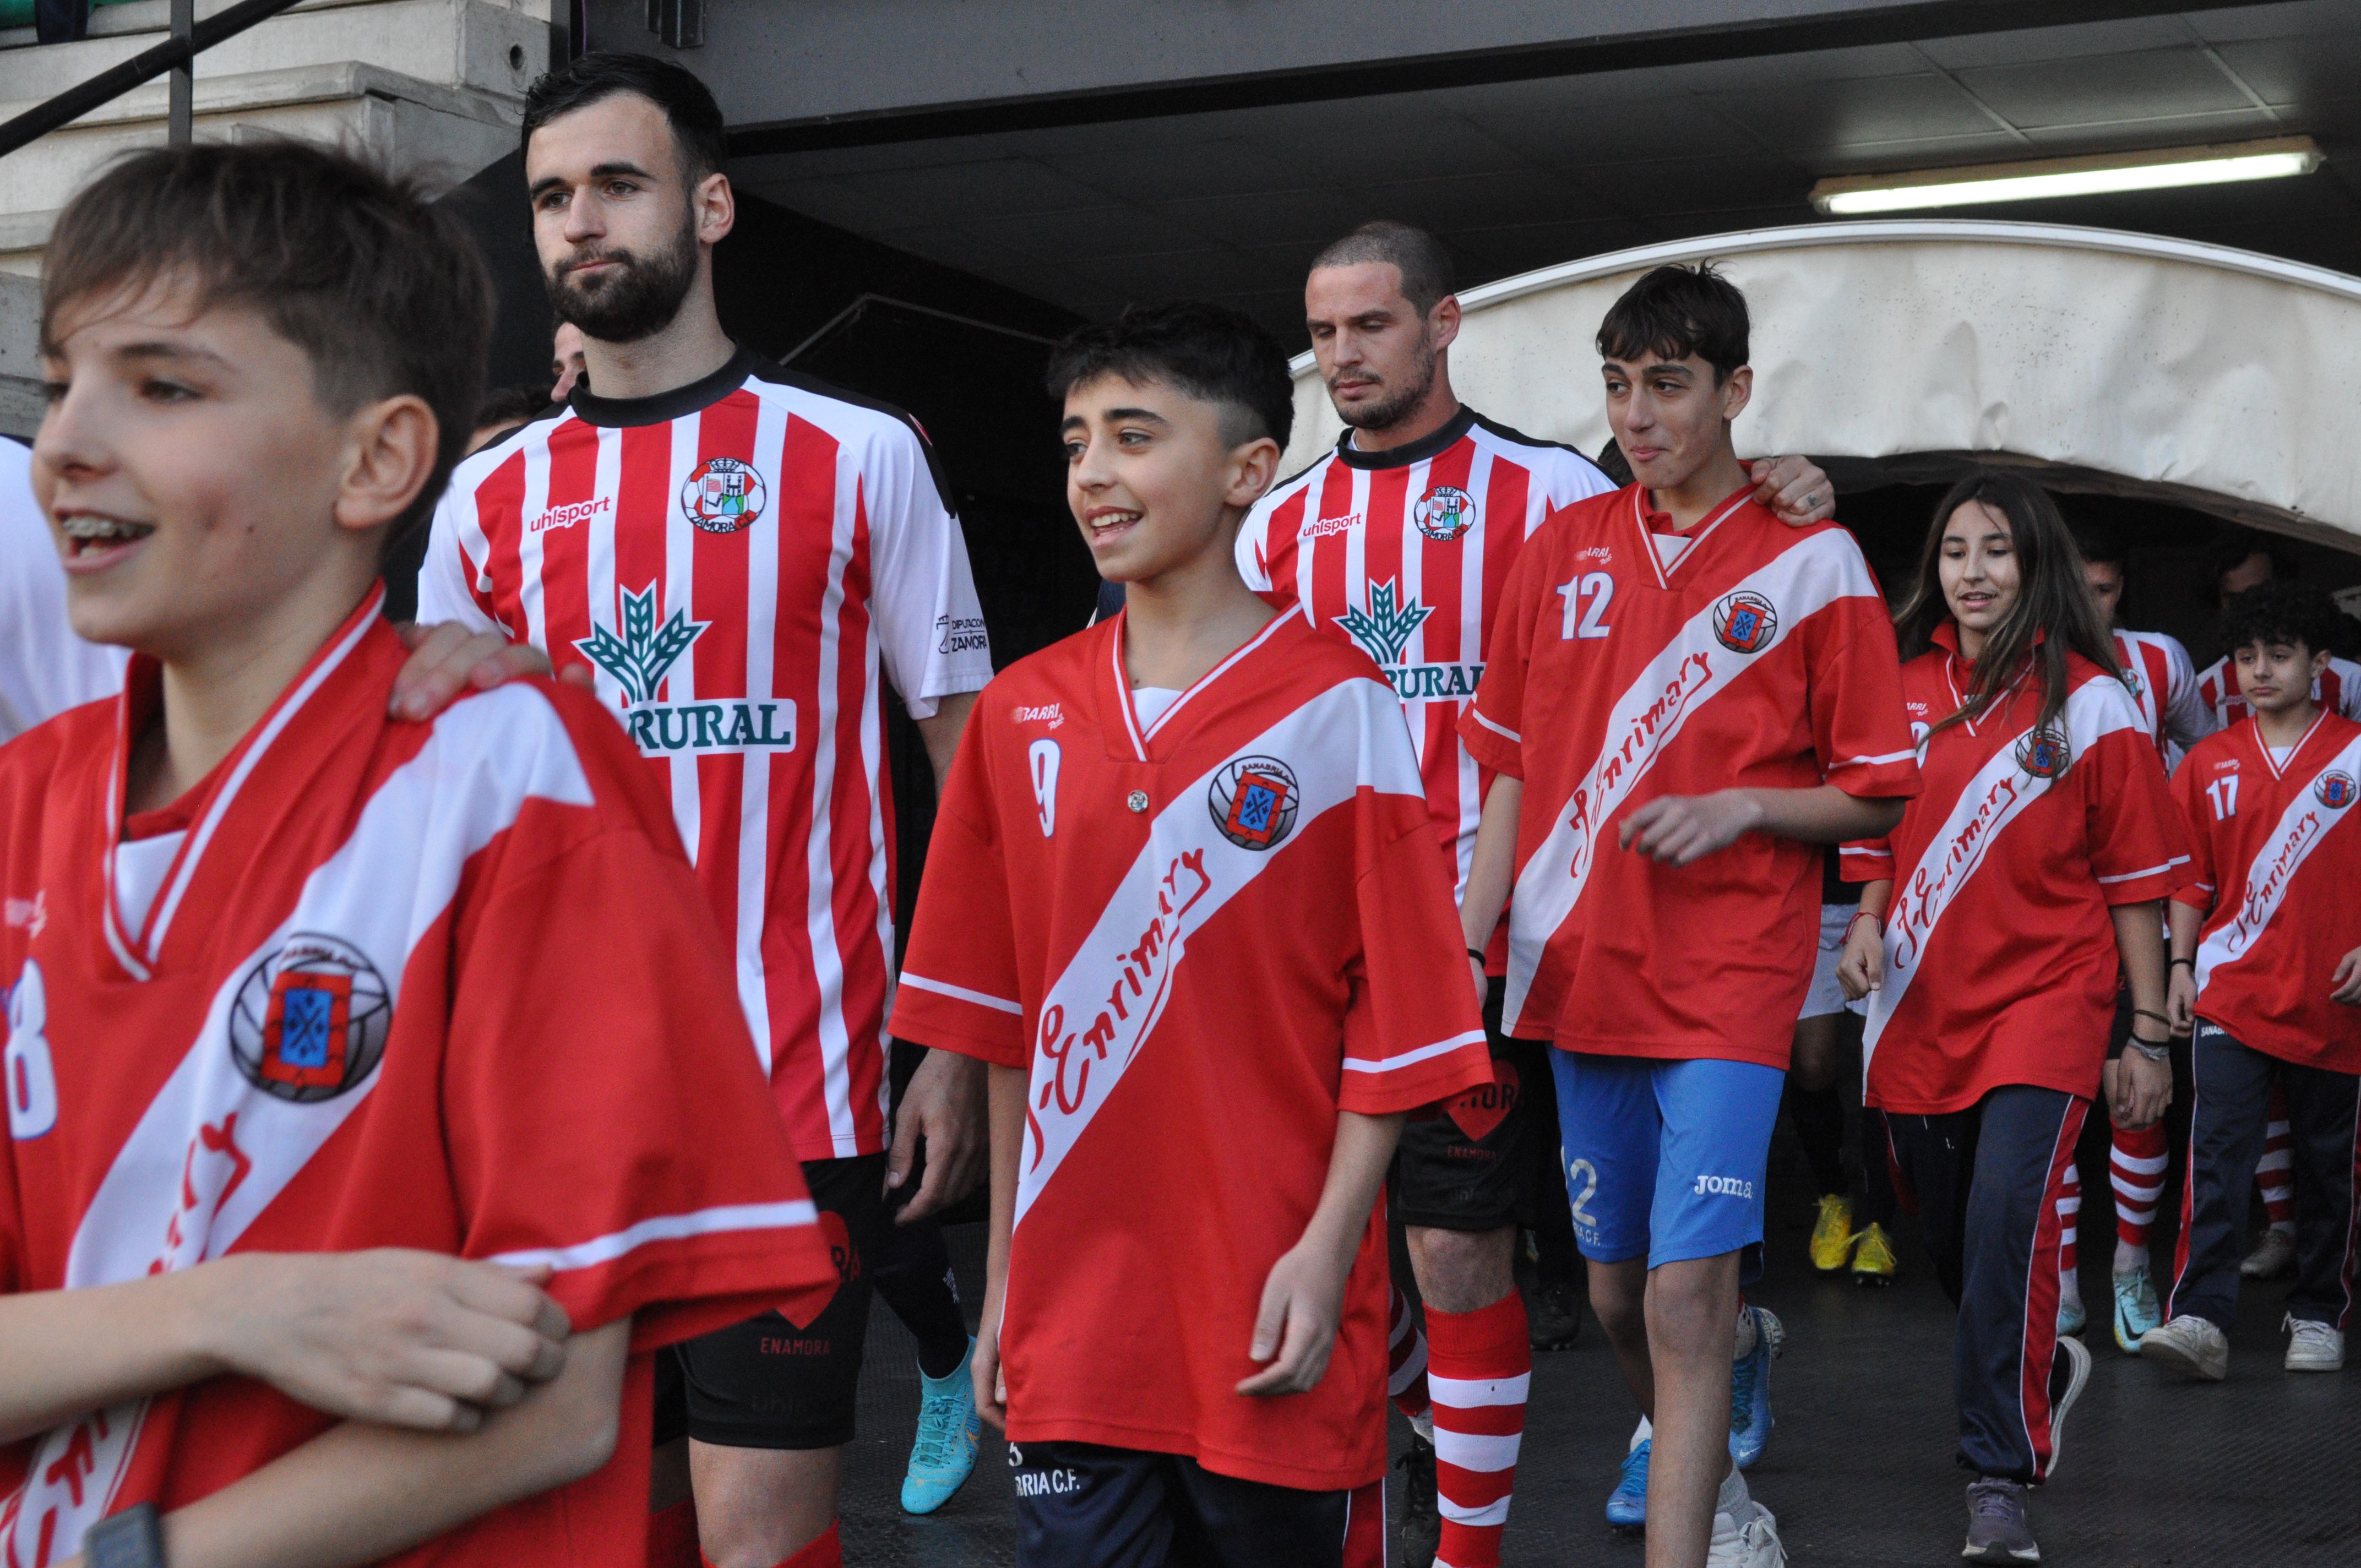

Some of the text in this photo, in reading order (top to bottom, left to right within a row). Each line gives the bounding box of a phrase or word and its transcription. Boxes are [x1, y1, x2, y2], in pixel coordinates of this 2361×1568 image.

[530, 497, 611, 532] uhlsport
[690, 514, 737, 533] ZAMORA
[1303, 513, 1361, 537] uhlsport
[1421, 527, 1453, 540] ZAMORA
[1555, 571, 1614, 640] 12
[951, 635, 988, 652] ZAMORA
[628, 704, 791, 750] RURAL
[1029, 737, 1062, 839] 9
[2205, 774, 2239, 821] 17
[760, 1337, 831, 1355] ENAMORA
[1052, 1468, 1080, 1493] C.F.
